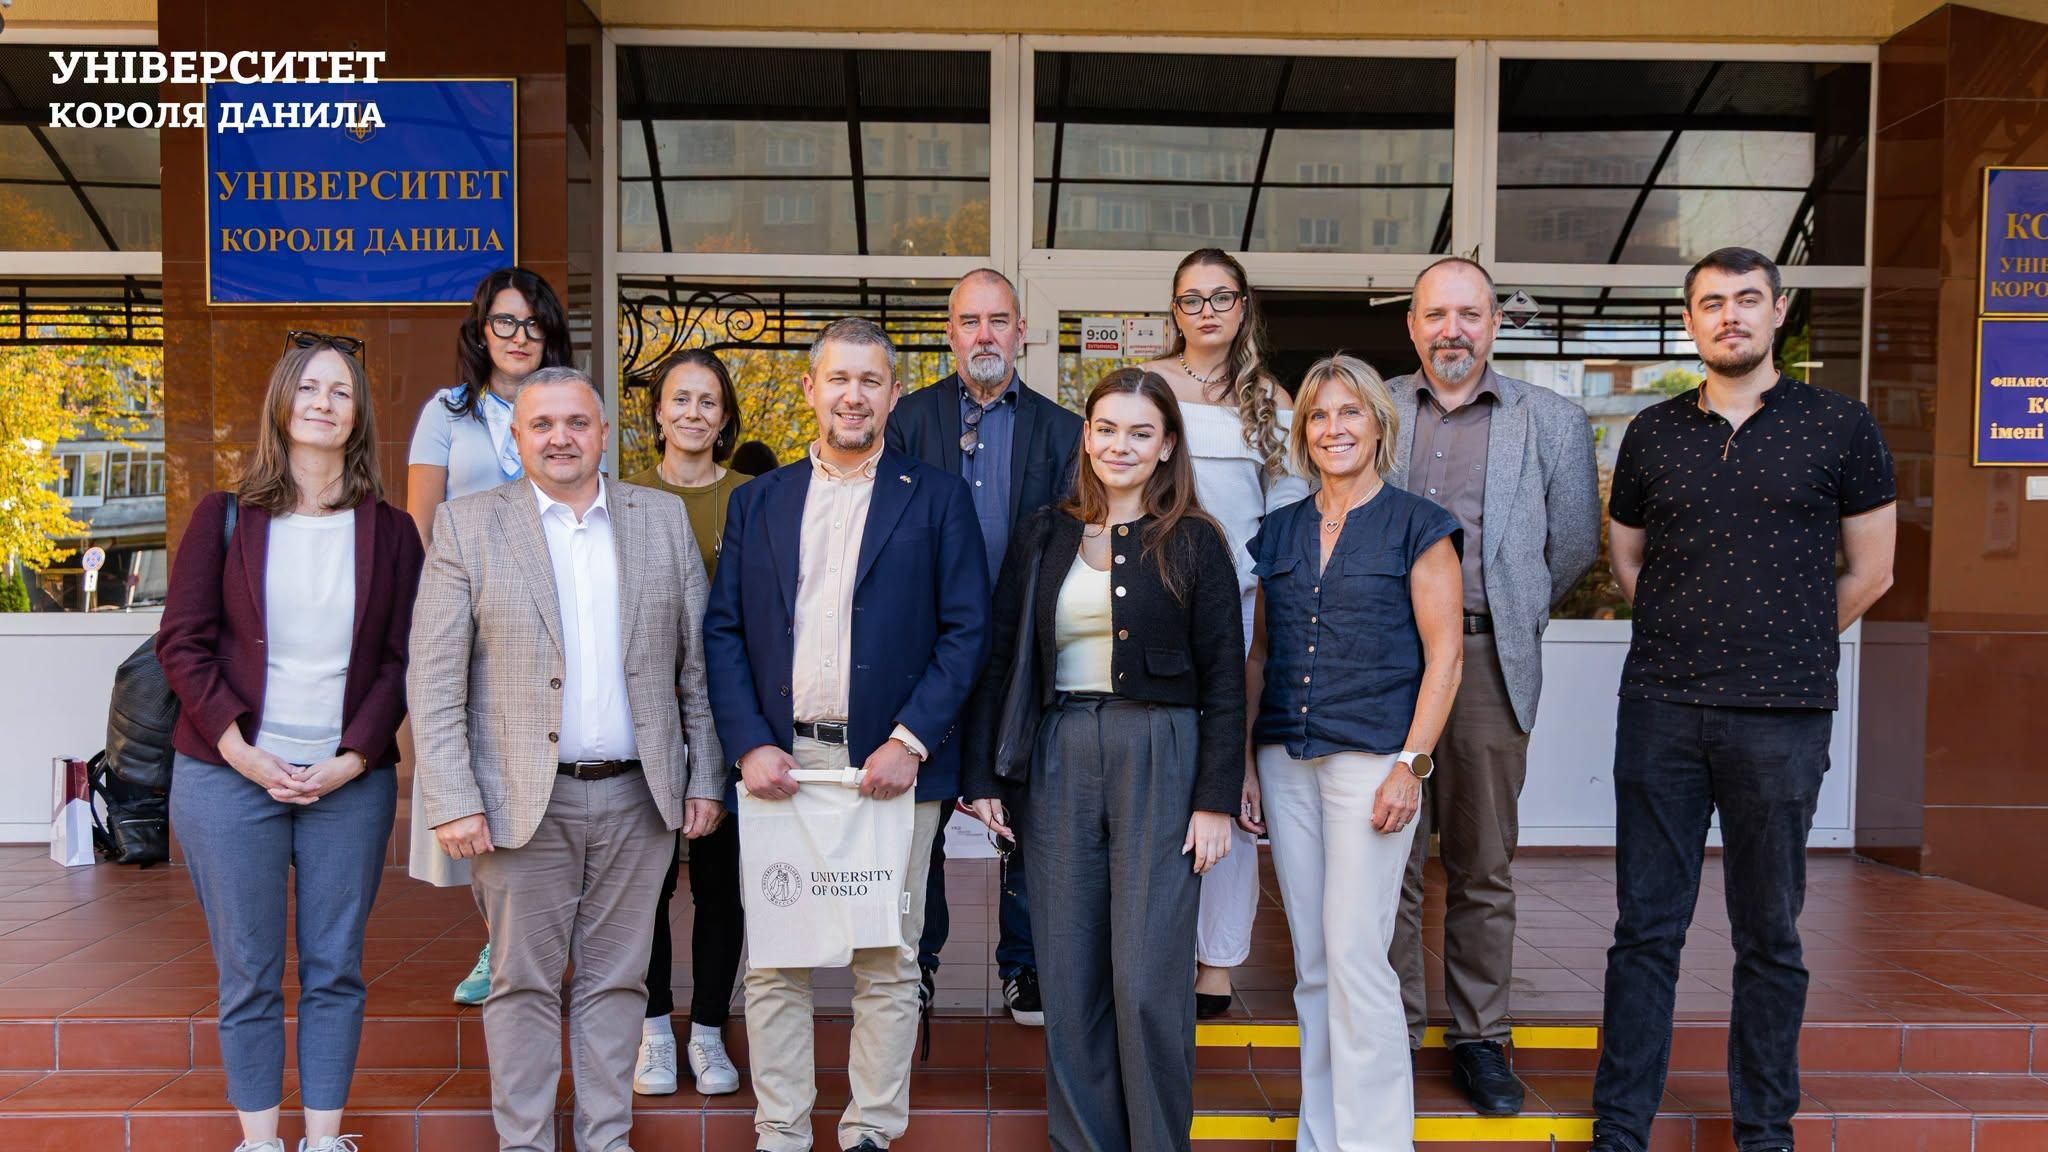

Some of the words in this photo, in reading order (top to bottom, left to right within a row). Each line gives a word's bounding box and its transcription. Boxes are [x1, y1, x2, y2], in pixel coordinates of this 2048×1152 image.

[216, 170, 508, 201] УНІВЕРСИТЕТ
[220, 228, 355, 252] КОРОЛЯ
[363, 228, 504, 256] ДАНИЛА
[1087, 329, 1118, 340] 9:00
[2027, 397, 2048, 414] К
[1990, 422, 2044, 440] імені
[811, 870, 893, 883] UNIVERSITY
[811, 885, 828, 896] OF
[830, 885, 868, 897] OSLO
